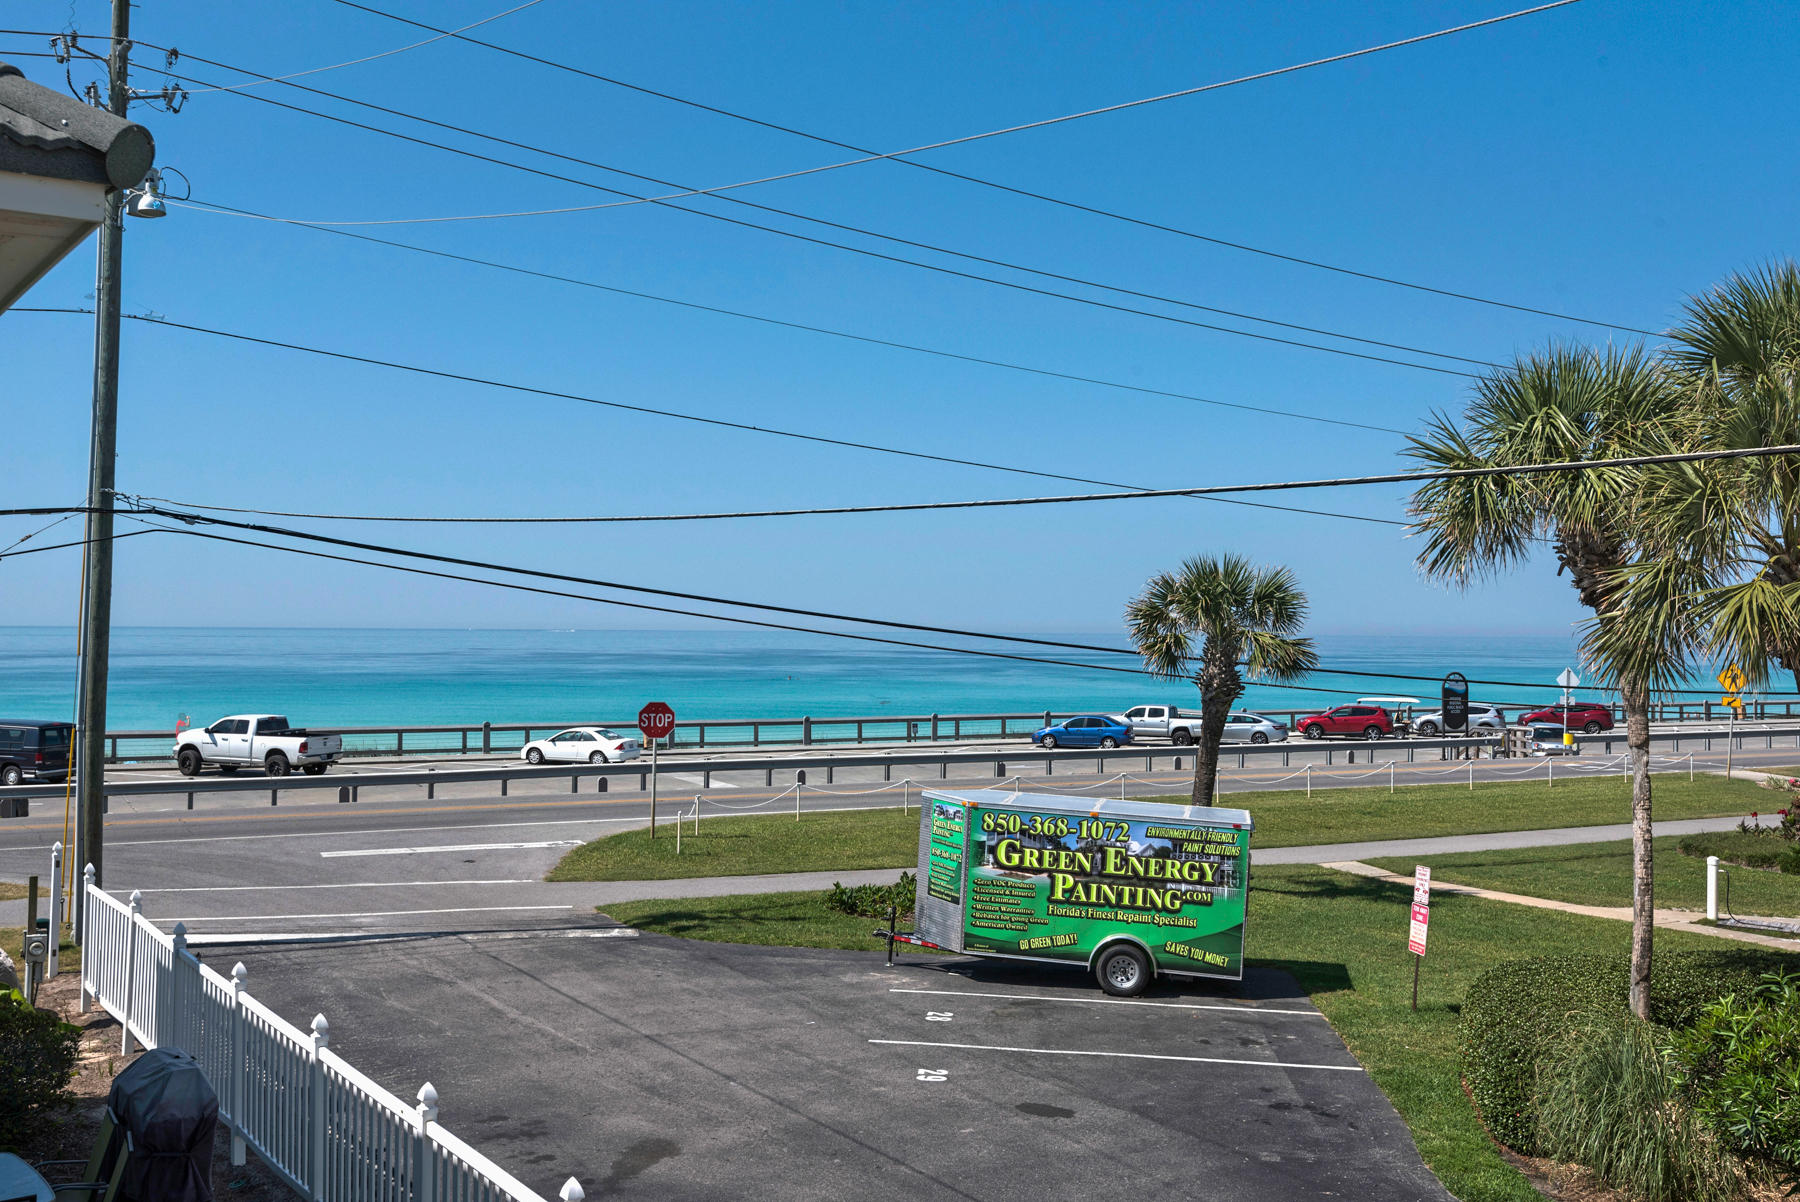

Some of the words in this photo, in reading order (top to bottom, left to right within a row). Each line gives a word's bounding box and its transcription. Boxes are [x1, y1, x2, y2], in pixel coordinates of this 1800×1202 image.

[641, 713, 673, 727] STOP
[983, 812, 1130, 842] 850-368-1072
[1147, 827, 1206, 841] ENVIRONMENTALLY
[1208, 832, 1239, 843] FRIENDLY
[1183, 842, 1201, 853] PAINT
[1204, 844, 1240, 856] SOLUTIONS
[997, 839, 1093, 873] GREEN
[1103, 847, 1219, 883] ENERGY
[1008, 881, 1035, 889] Products
[991, 896, 1021, 904] Estimates
[976, 912, 999, 920] Rebates
[1048, 904, 1085, 917] Florida's
[1088, 908, 1114, 920] Finest
[1116, 911, 1151, 924] Repaint
[1154, 914, 1197, 927] Specialist
[975, 920, 1004, 928] American
[1019, 940, 1029, 950] GO
[1030, 936, 1052, 948] GREEN
[1052, 933, 1078, 947] TODAY!
[1165, 941, 1189, 955] SAVES
[1190, 948, 1205, 959] YOU
[1205, 952, 1230, 967] MONEY
